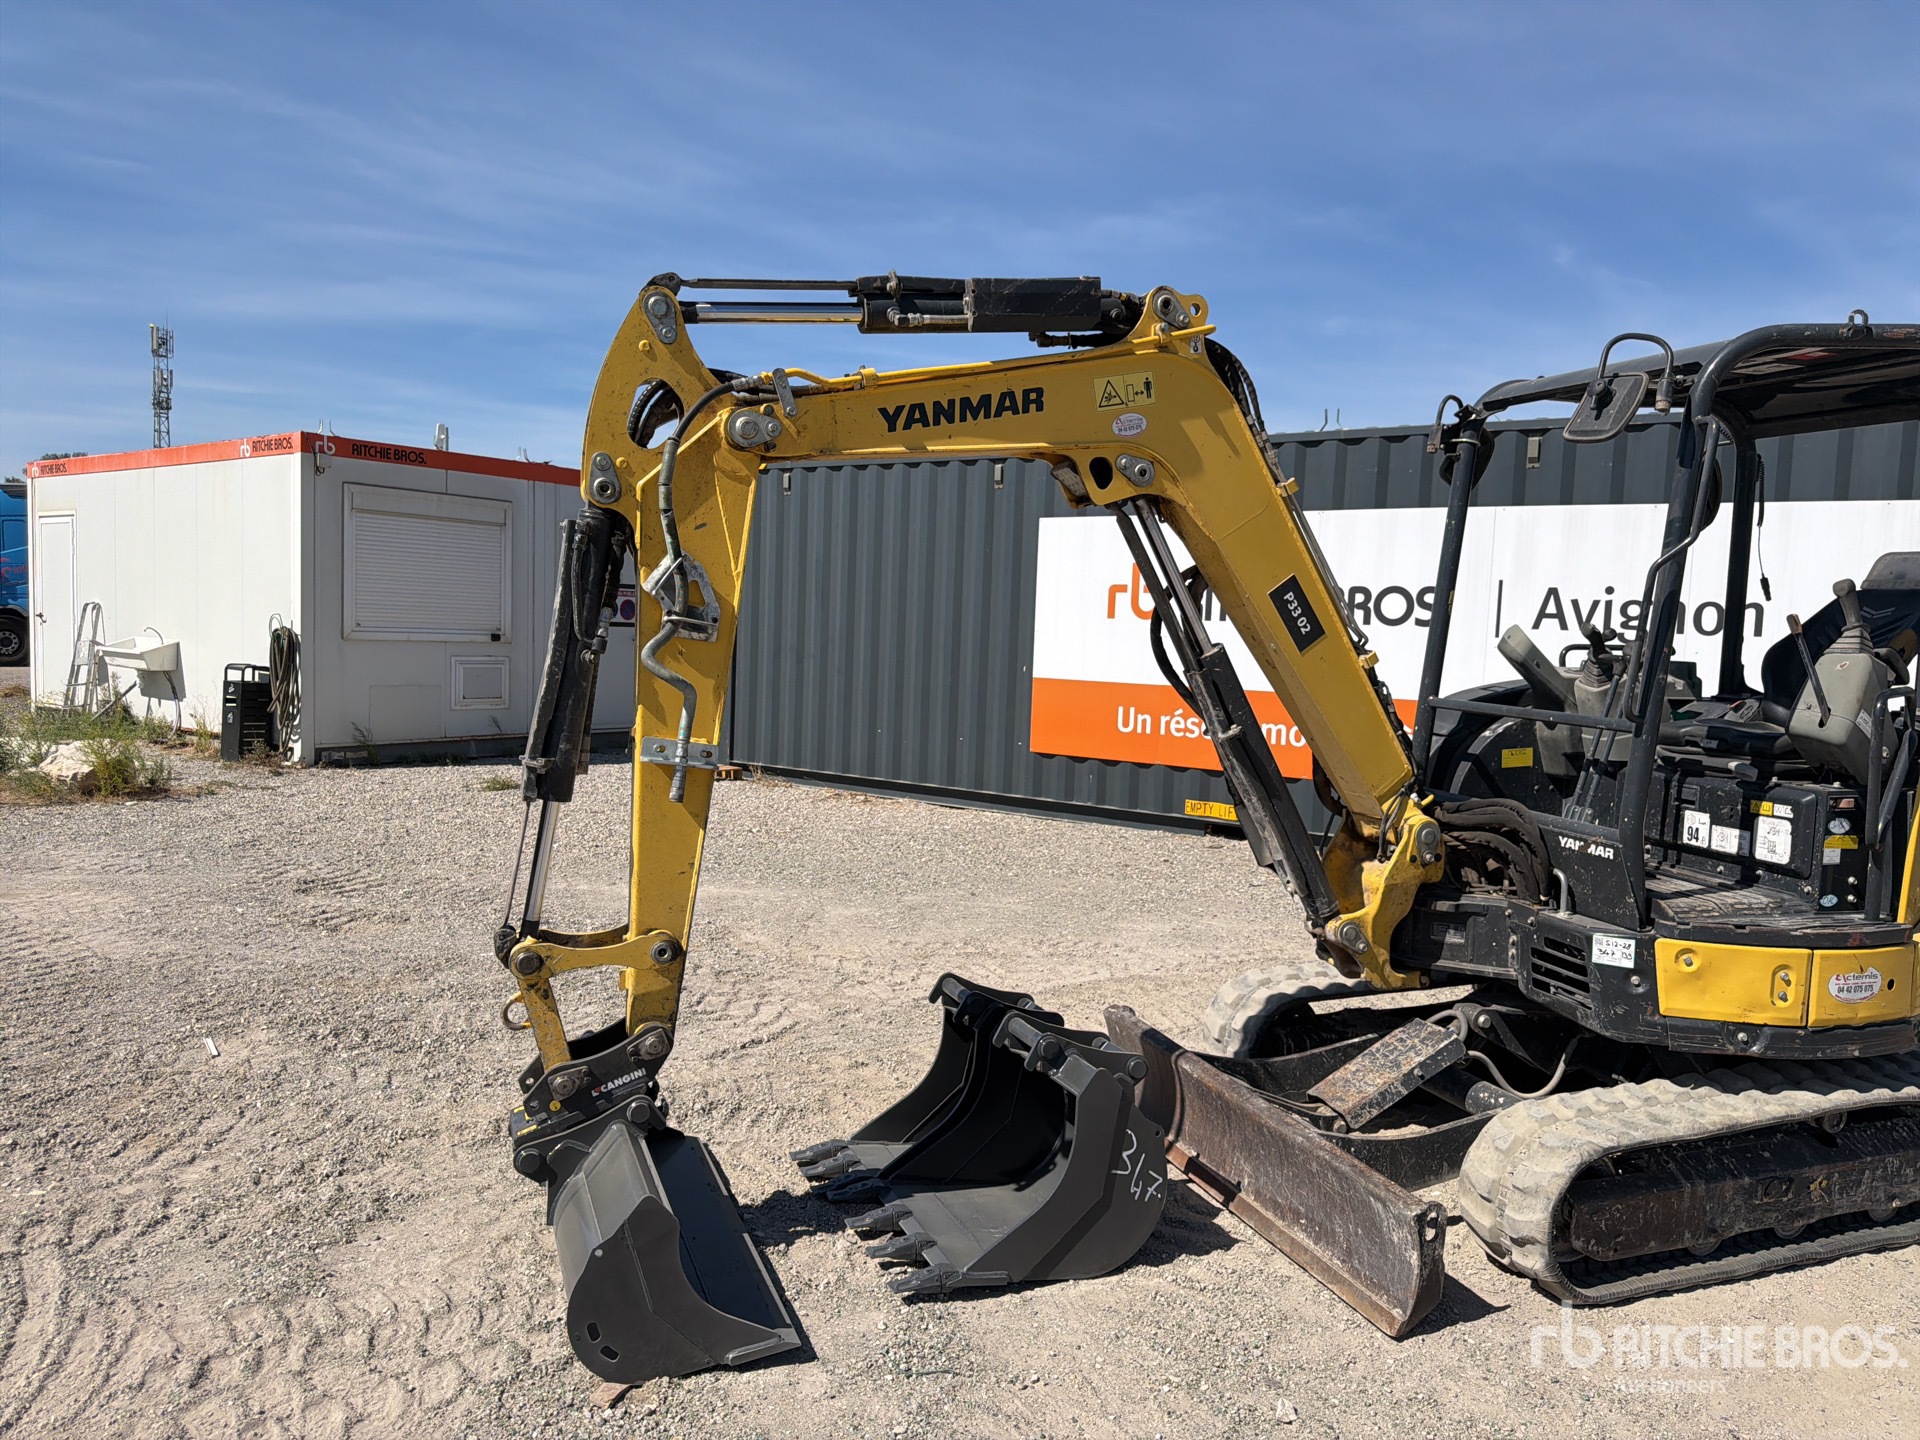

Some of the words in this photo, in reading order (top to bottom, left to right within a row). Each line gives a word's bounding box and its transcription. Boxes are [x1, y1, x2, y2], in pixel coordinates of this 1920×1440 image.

[877, 387, 1045, 433] YANMAR
[252, 439, 273, 453] RITCHIE
[273, 437, 294, 450] BROS.
[315, 435, 336, 455] rb
[351, 443, 392, 460] RITCHIE
[394, 448, 427, 465] BROS.
[40, 464, 55, 476] RITCHIE
[1283, 591, 1302, 617] P33
[1297, 616, 1311, 635] 02
[1117, 706, 1151, 735] Un
[1186, 801, 1214, 815] EMPTY
[1219, 805, 1237, 819] LIF
[1687, 825, 1700, 843] 94
[1835, 971, 1878, 983] Actemis
[1837, 986, 1845, 994] 04
[1846, 985, 1853, 994] 42
[1853, 985, 1863, 993] 075
[1864, 984, 1874, 992] 075
[600, 1067, 647, 1093] CANGINI
